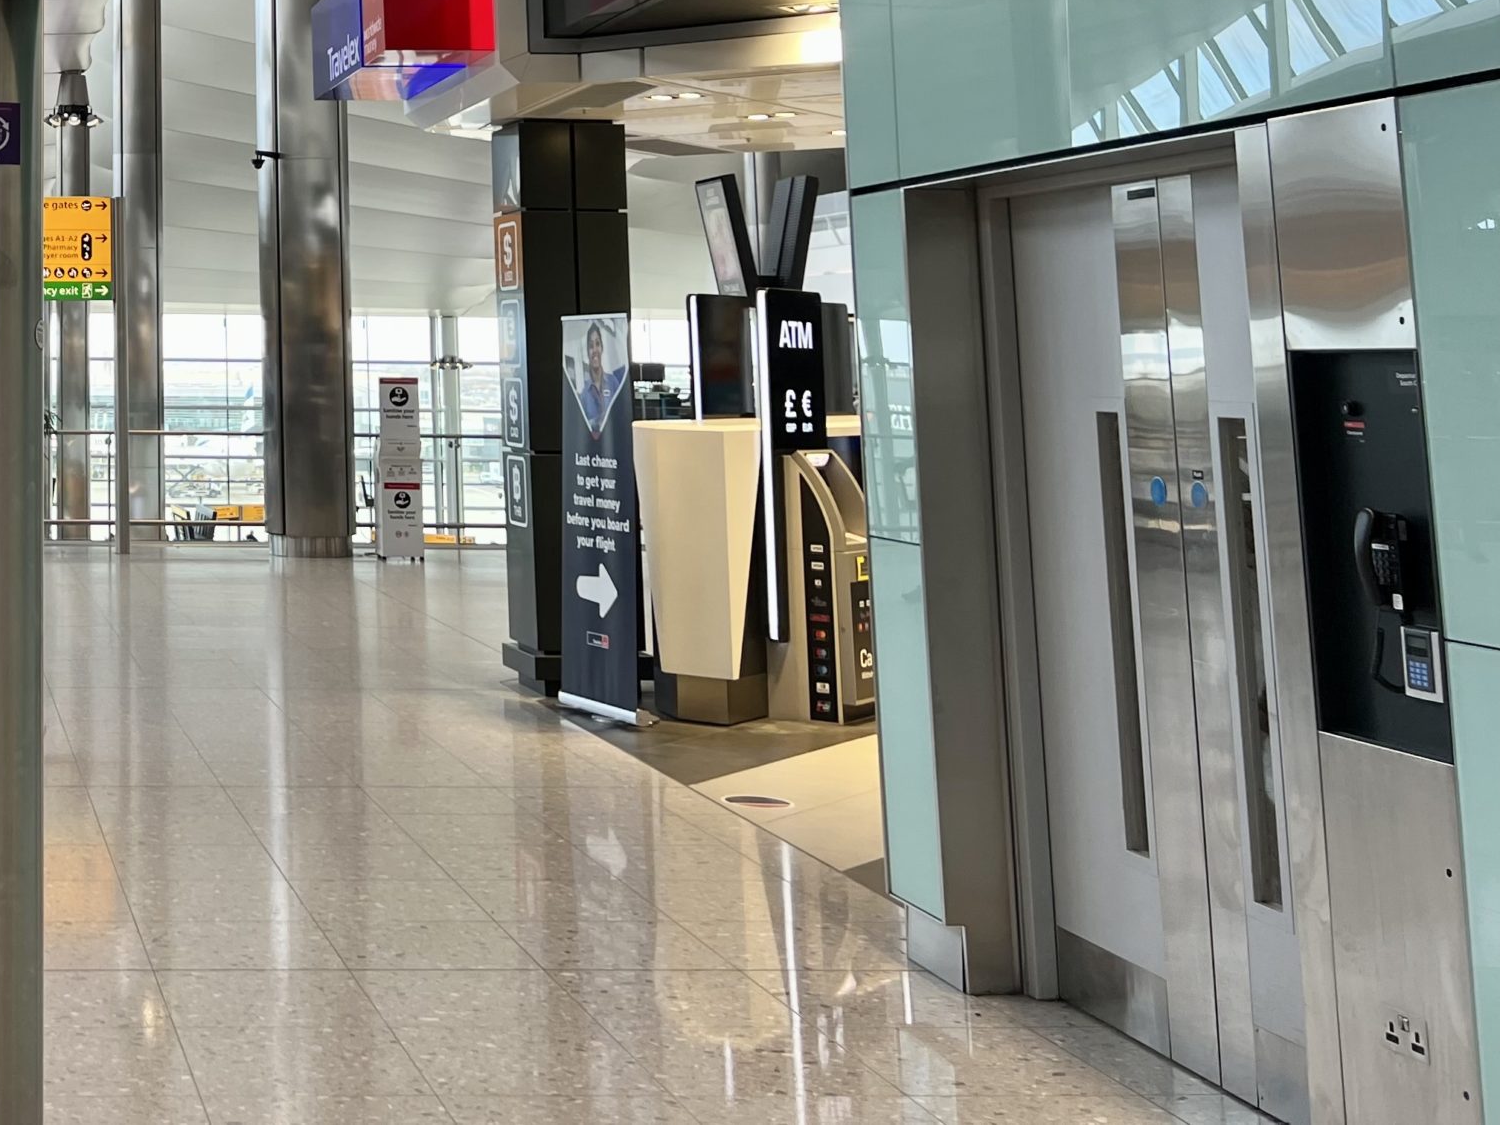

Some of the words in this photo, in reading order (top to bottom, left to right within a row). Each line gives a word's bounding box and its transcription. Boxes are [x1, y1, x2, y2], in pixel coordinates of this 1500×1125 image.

[327, 34, 360, 82] Travelex
[52, 202, 78, 210] gates
[59, 286, 78, 295] exit
[779, 320, 813, 349] ATM
[784, 389, 797, 418] £
[801, 390, 812, 417] €
[575, 453, 590, 466] Last
[591, 454, 617, 469] chance
[577, 473, 584, 486] to
[585, 475, 599, 490] get
[600, 478, 616, 491] your
[573, 493, 594, 507] travel
[596, 498, 620, 513] money
[566, 511, 590, 527] before
[591, 518, 606, 531] you
[607, 517, 629, 532] board
[577, 536, 594, 549] your
[596, 536, 616, 553] flight
